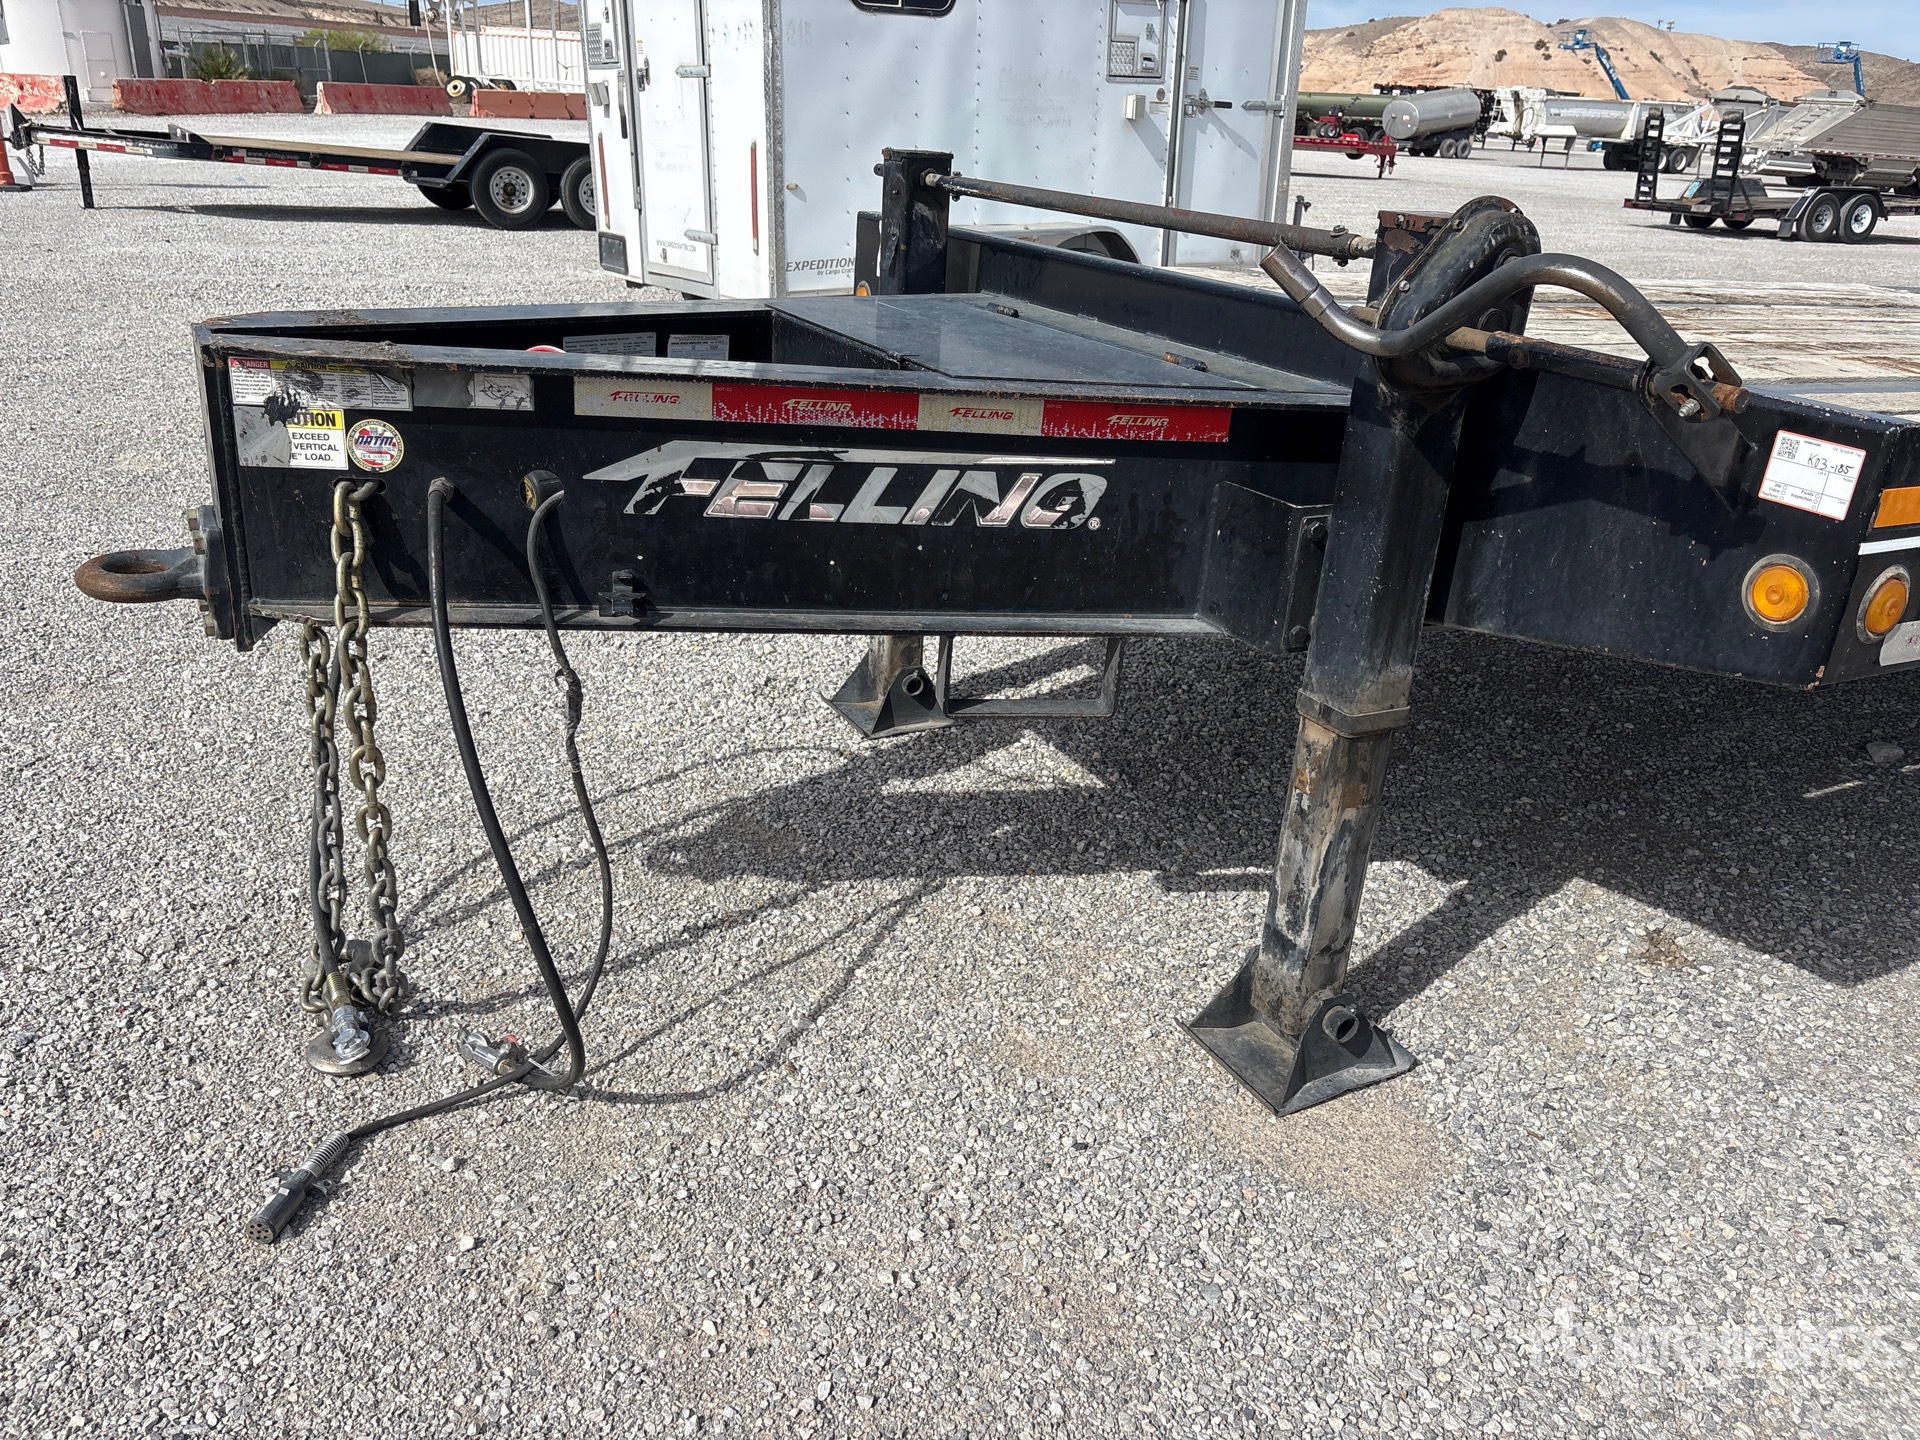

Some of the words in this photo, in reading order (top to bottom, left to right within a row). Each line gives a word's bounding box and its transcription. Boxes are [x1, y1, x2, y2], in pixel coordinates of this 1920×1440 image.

[786, 257, 855, 272] EXPEDITION
[295, 362, 327, 371] CAUTION
[782, 398, 852, 412] FELLING
[948, 407, 1014, 420] FELLING
[1106, 415, 1169, 427] FELLING
[292, 432, 330, 441] EXCEED
[355, 435, 394, 447] NATM
[293, 442, 339, 452] VERTICAL
[305, 453, 333, 461] LOAD.
[583, 440, 1116, 529] FELLING
